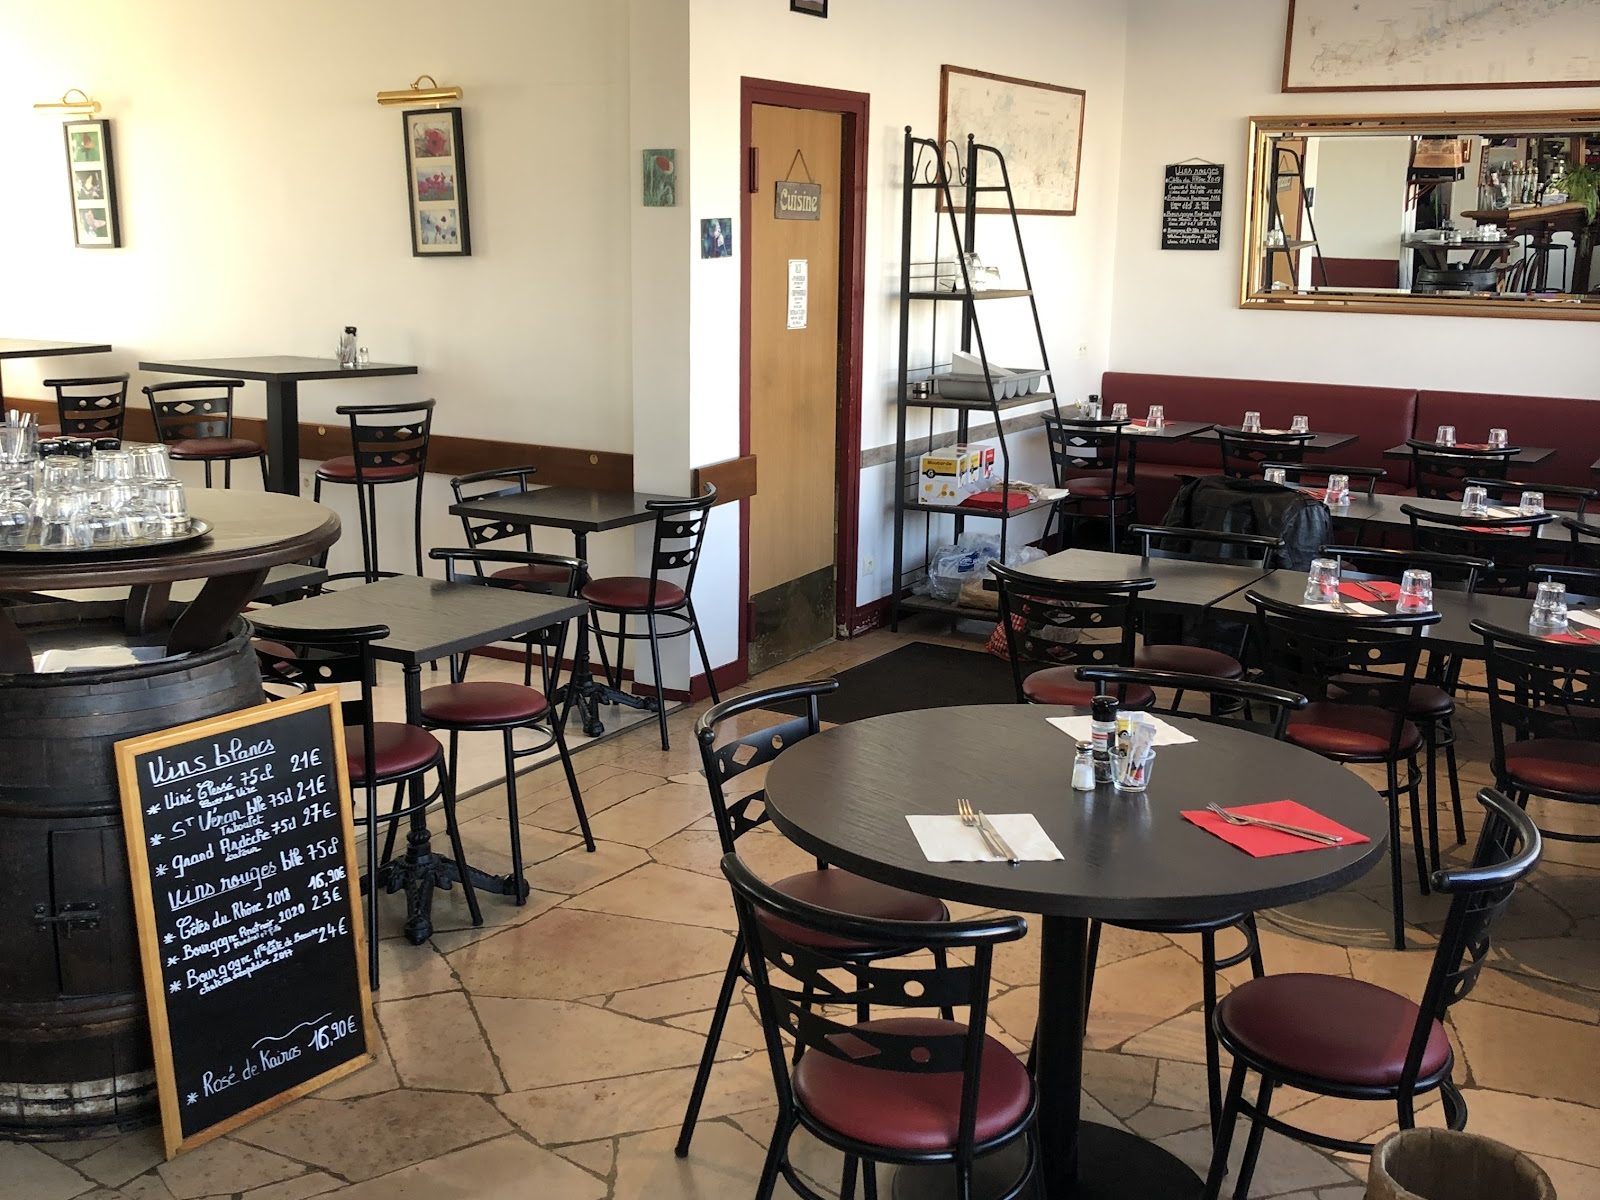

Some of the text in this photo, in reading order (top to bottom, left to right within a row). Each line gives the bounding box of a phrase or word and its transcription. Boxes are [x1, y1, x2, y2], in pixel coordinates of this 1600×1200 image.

[780, 188, 818, 212] Cuisine
[148, 737, 275, 786] Vins blancs
[164, 788, 195, 810] Viré
[290, 748, 323, 773] 21€
[198, 805, 246, 831] Véran
[296, 775, 327, 802] 21€
[302, 802, 338, 827] 27€
[168, 882, 217, 911] Vins
[220, 861, 278, 892] rouges
[176, 915, 211, 940] Côtes
[211, 911, 233, 929] du
[232, 899, 264, 921] Rhône
[266, 887, 292, 908] 2018
[182, 932, 239, 961] Bourgogne
[277, 902, 306, 924] 2020
[311, 886, 343, 911] 23€
[186, 953, 253, 989] Bourgogne
[318, 917, 349, 944] 24€
[202, 1066, 241, 1097] Rosé
[242, 1058, 260, 1081] de
[308, 1015, 357, 1052] 16,90€
